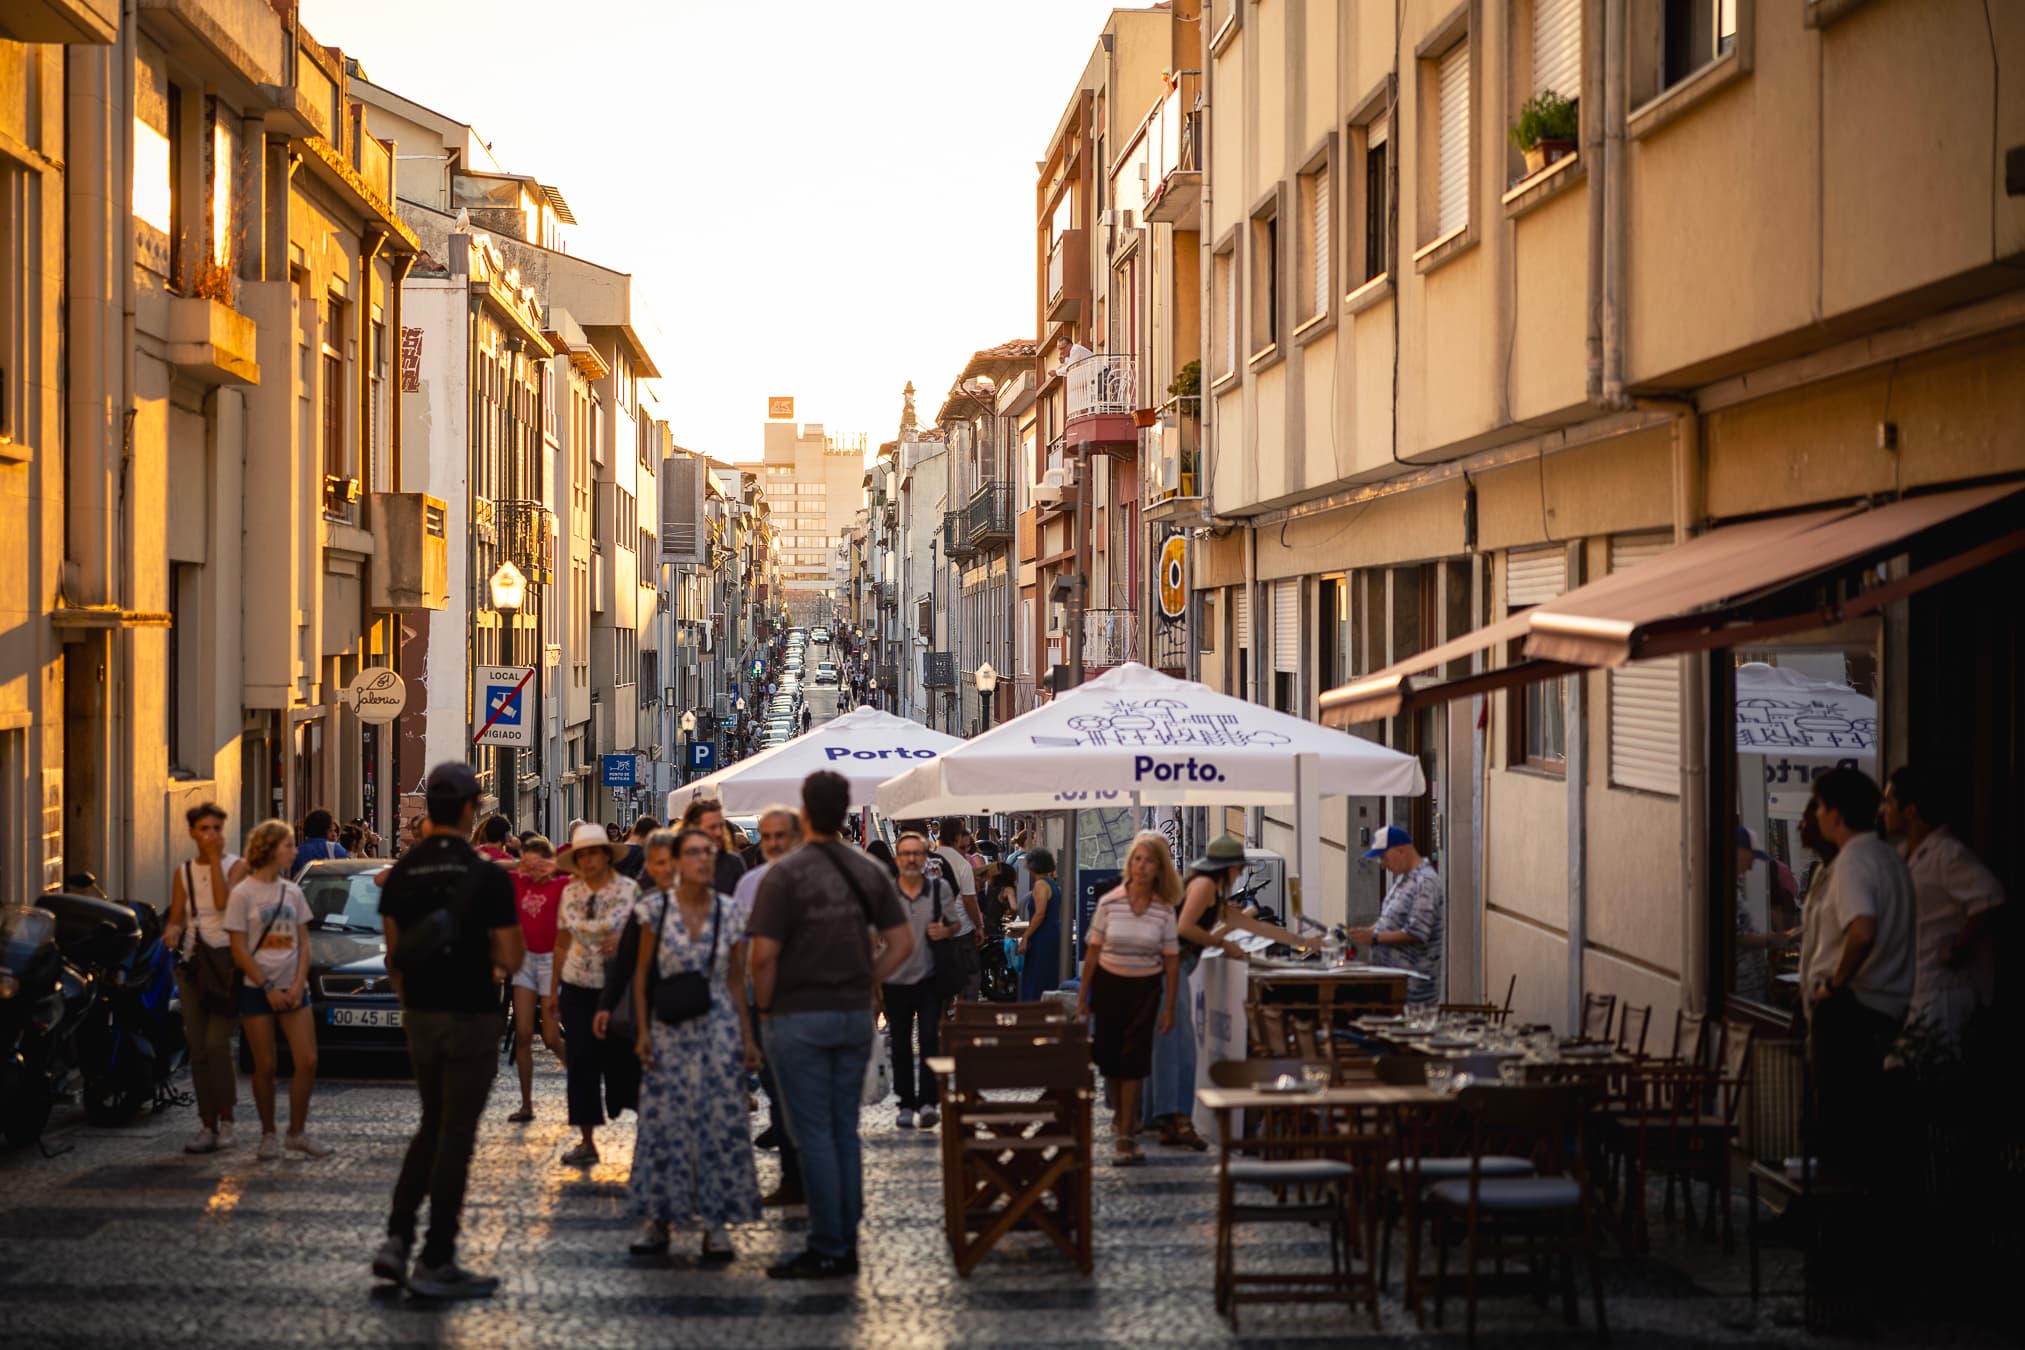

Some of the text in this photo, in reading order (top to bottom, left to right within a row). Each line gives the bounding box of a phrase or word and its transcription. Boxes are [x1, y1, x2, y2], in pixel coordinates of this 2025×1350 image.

[490, 672, 520, 681] LOCAL
[484, 730, 522, 740] VIGIADO
[695, 745, 710, 764] P
[824, 747, 937, 760] Porto
[1134, 755, 1226, 783] Porto.
